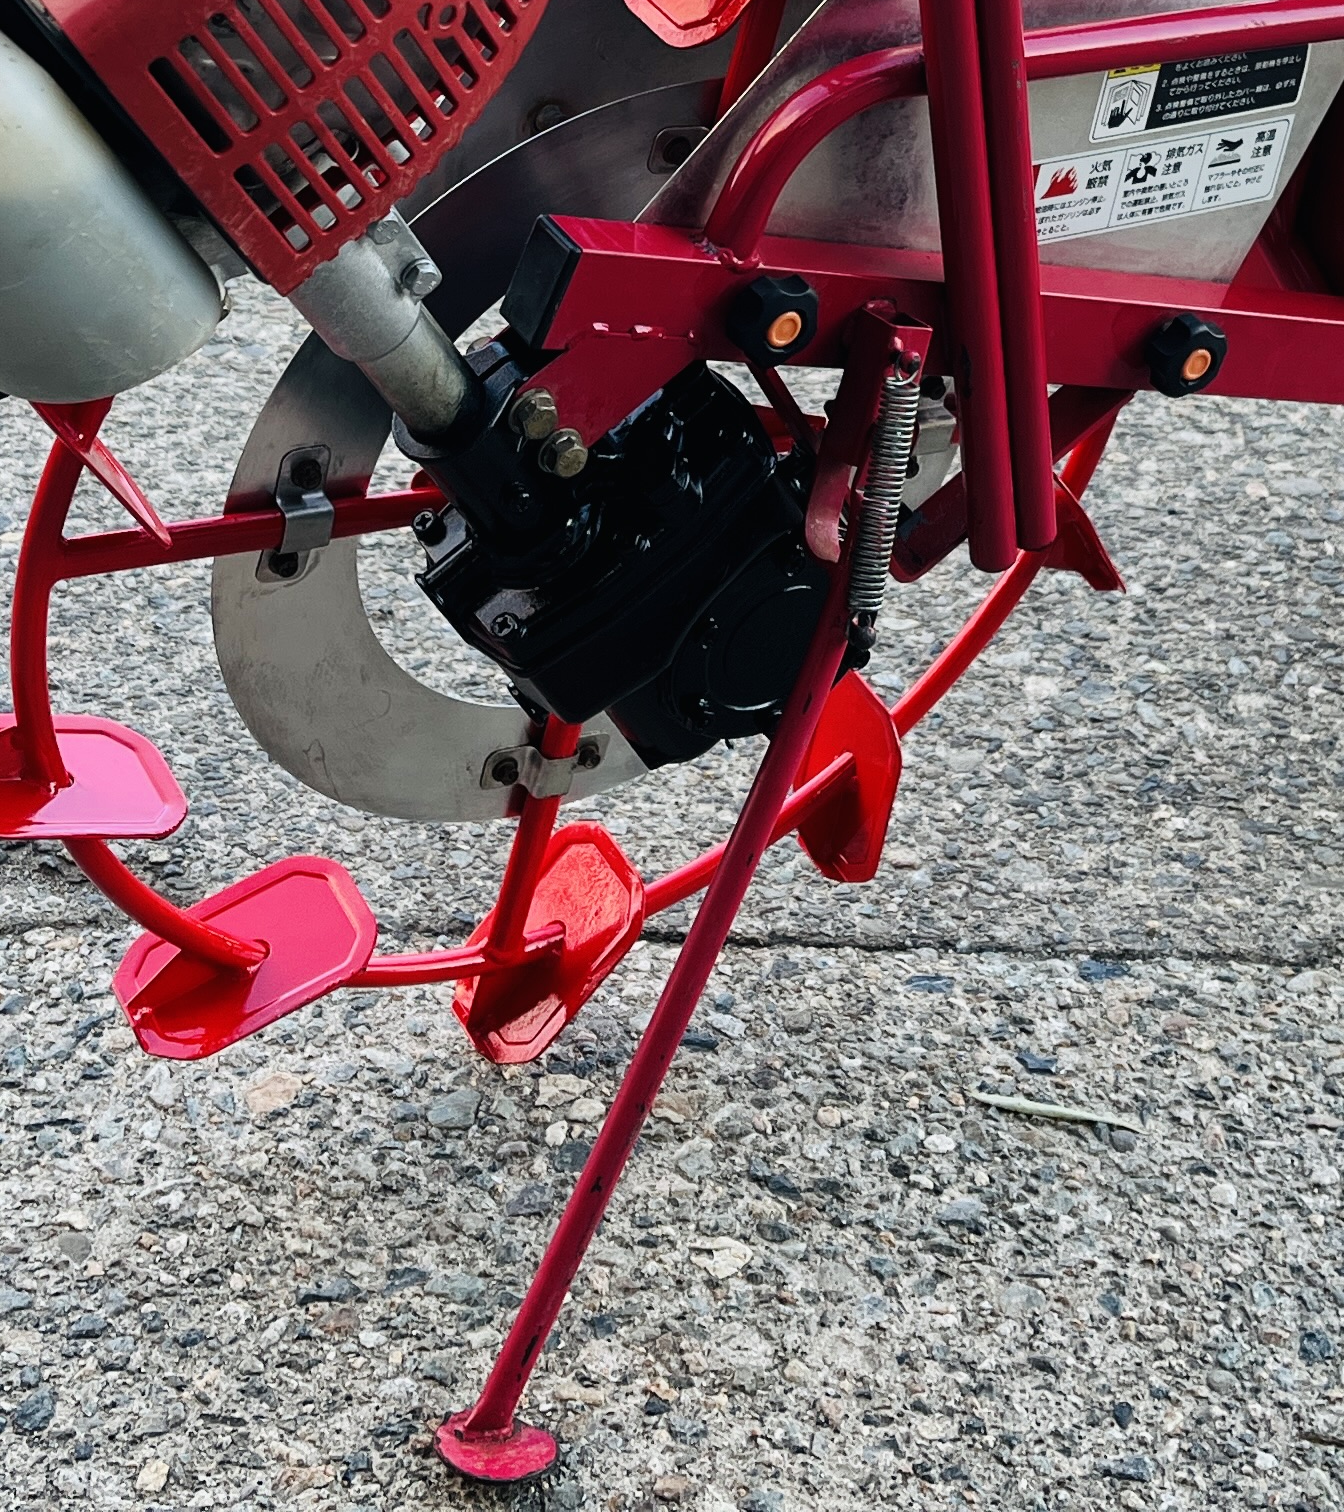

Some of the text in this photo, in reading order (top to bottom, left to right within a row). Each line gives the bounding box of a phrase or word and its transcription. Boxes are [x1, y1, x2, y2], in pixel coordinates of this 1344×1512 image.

[1255, 129, 1277, 143] 高温
[1165, 143, 1204, 161] 排気ガス
[1250, 144, 1273, 159] 注意
[1089, 159, 1113, 175] 火気
[1161, 161, 1182, 176] 注意
